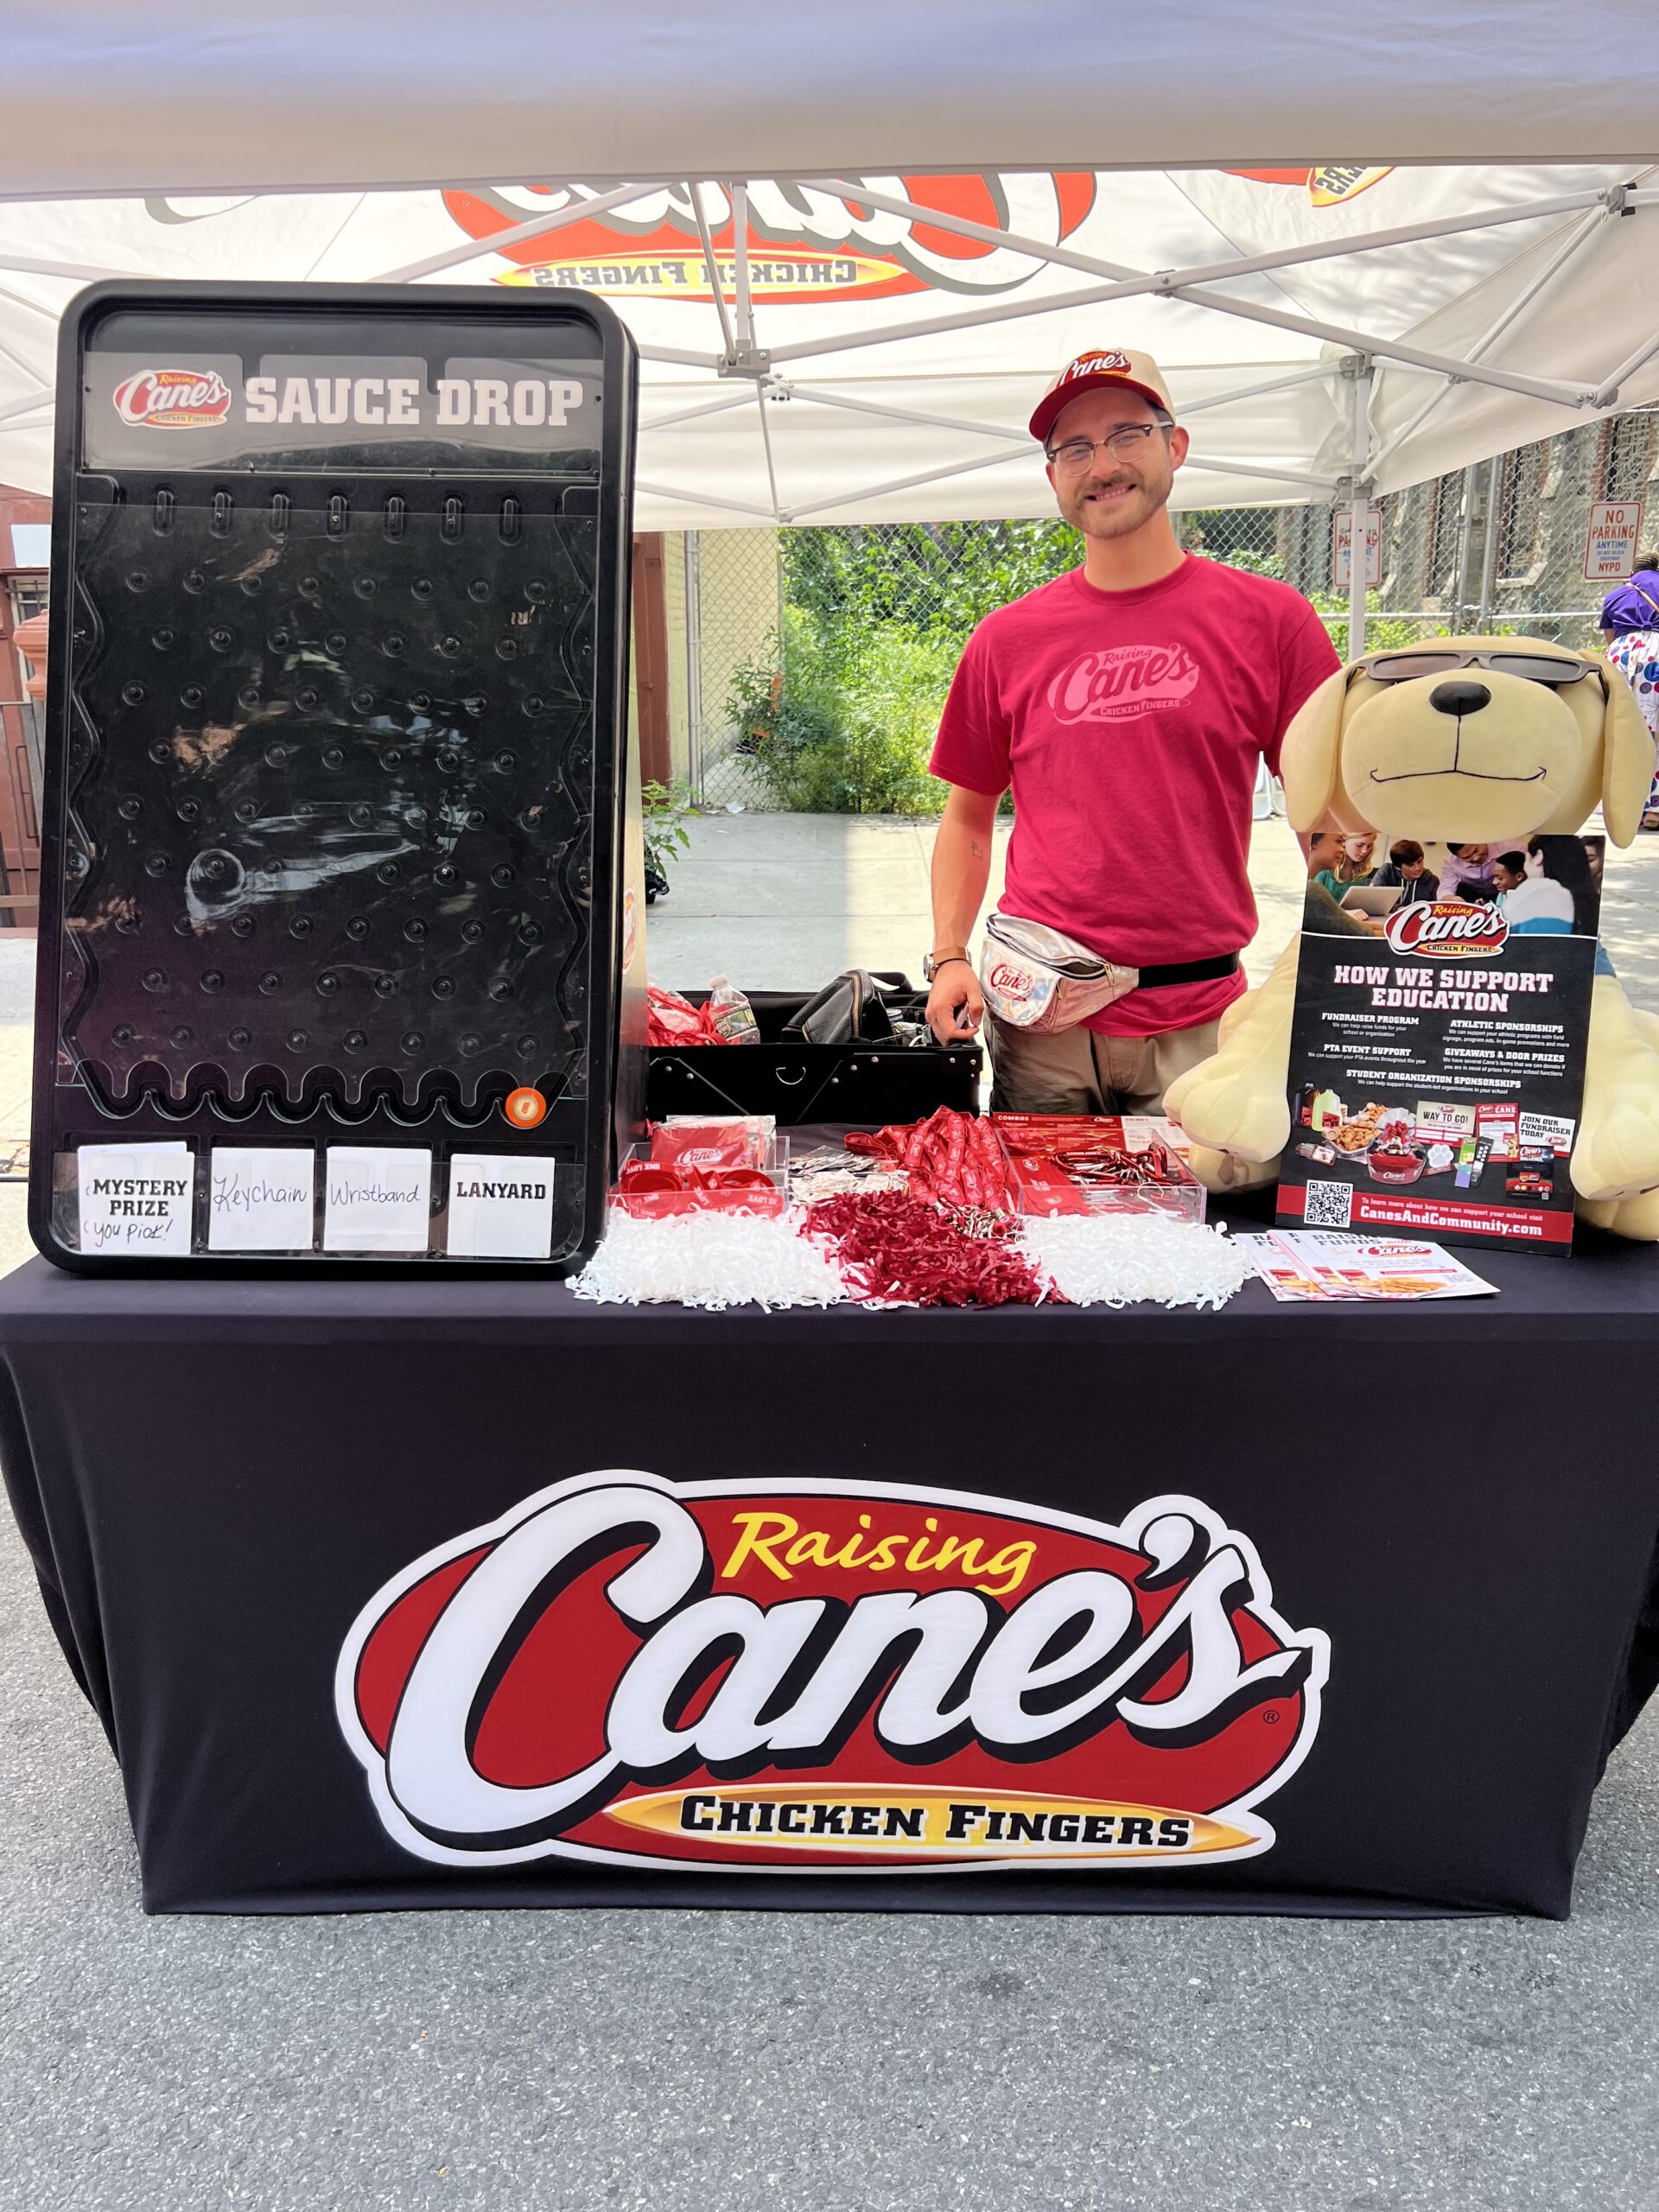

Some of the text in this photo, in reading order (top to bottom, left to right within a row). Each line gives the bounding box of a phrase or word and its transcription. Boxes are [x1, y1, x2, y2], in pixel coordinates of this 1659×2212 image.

[1059, 351, 1129, 386] Cane's
[121, 372, 228, 422] Cane's
[245, 378, 583, 426] SAUCE DROP
[1605, 510, 1624, 524] NO
[1592, 525, 1635, 539] PARKING
[1596, 540, 1628, 549] ANYTIME
[1599, 563, 1621, 572] NYPD
[1103, 648, 1153, 666] Raising
[1053, 646, 1198, 721] Cane's
[1099, 699, 1180, 716] CHICKEN FINGERS
[1433, 905, 1473, 917] Raising
[1389, 901, 1507, 950] Cane's
[991, 964, 1033, 991] Cane's
[1334, 965, 1554, 993] HOW WE SUPPORT
[1371, 988, 1510, 1013] EDUCATION
[1322, 1013, 1419, 1025] FUNDRAISER PROGRAM
[1451, 1020, 1563, 1033] ATHLETIC SPONSORSHIPS
[1324, 1044, 1412, 1056] PTA EVENT SUPPORT
[1445, 1048, 1496, 1058] GIVEAWAYS
[1506, 1052, 1530, 1060] DOOR
[1532, 1052, 1565, 1063] PRIZES
[1346, 1070, 1522, 1089] STUDENT ORGANIZATION SPONSORSHIPS
[1423, 1111, 1440, 1122] WAY
[1443, 1113, 1452, 1122] TO
[1455, 1115, 1468, 1123] GO!
[1521, 1122, 1571, 1135] FUNDRAISER
[1521, 1129, 1544, 1138] TODAY
[92, 1179, 188, 1197] MYSTERY
[213, 1173, 308, 1211] Keychain
[330, 1180, 422, 1205] Wristband
[456, 1181, 546, 1200] LANYARD
[109, 1199, 169, 1217] PRIZE
[1370, 1198, 1386, 1206] learn
[1464, 1208, 1488, 1217] support
[1507, 1211, 1528, 1220] school
[1360, 1205, 1542, 1236] CanesAndCommunity.com
[720, 1510, 1039, 1597] Raising
[386, 1483, 1313, 1837] Cane's
[680, 1795, 1194, 1847] CHICKEN FINGERS
